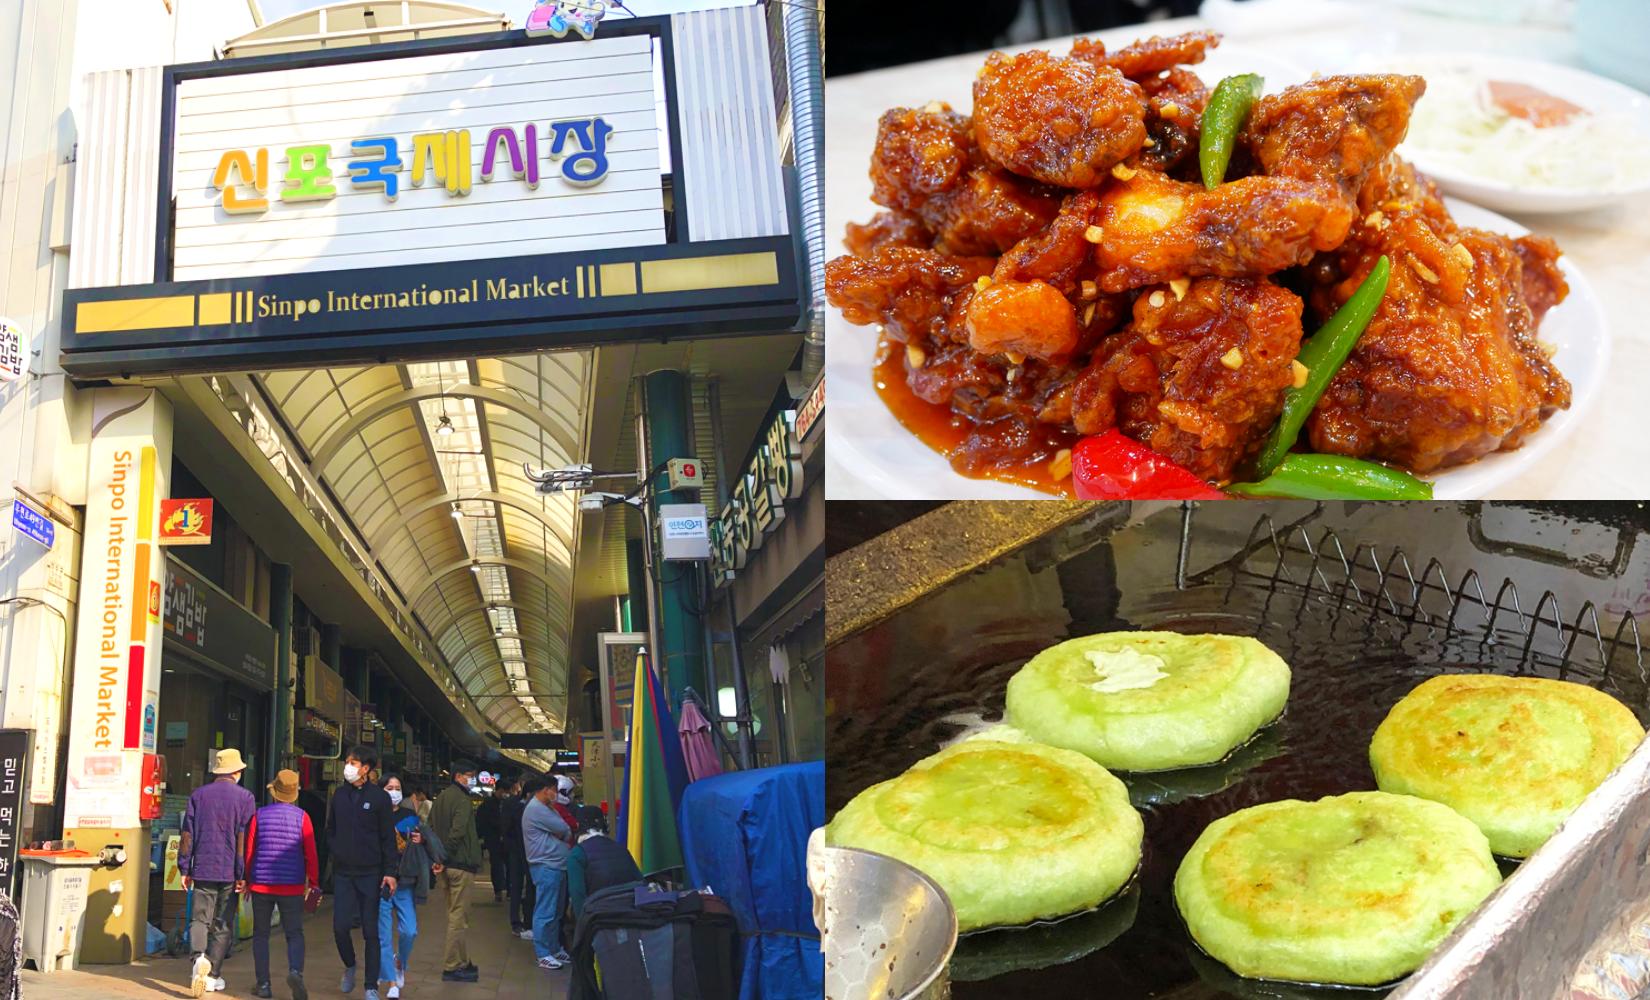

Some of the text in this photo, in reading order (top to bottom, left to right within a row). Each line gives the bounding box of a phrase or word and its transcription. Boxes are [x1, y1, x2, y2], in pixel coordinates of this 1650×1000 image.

[212, 116, 614, 214] 신포국제시장
[258, 274, 570, 323] Sinpo International Market
[94, 450, 132, 749] Sinpo International Market
[2, 758, 16, 794] 믿고
[0, 807, 13, 847] 먹는
